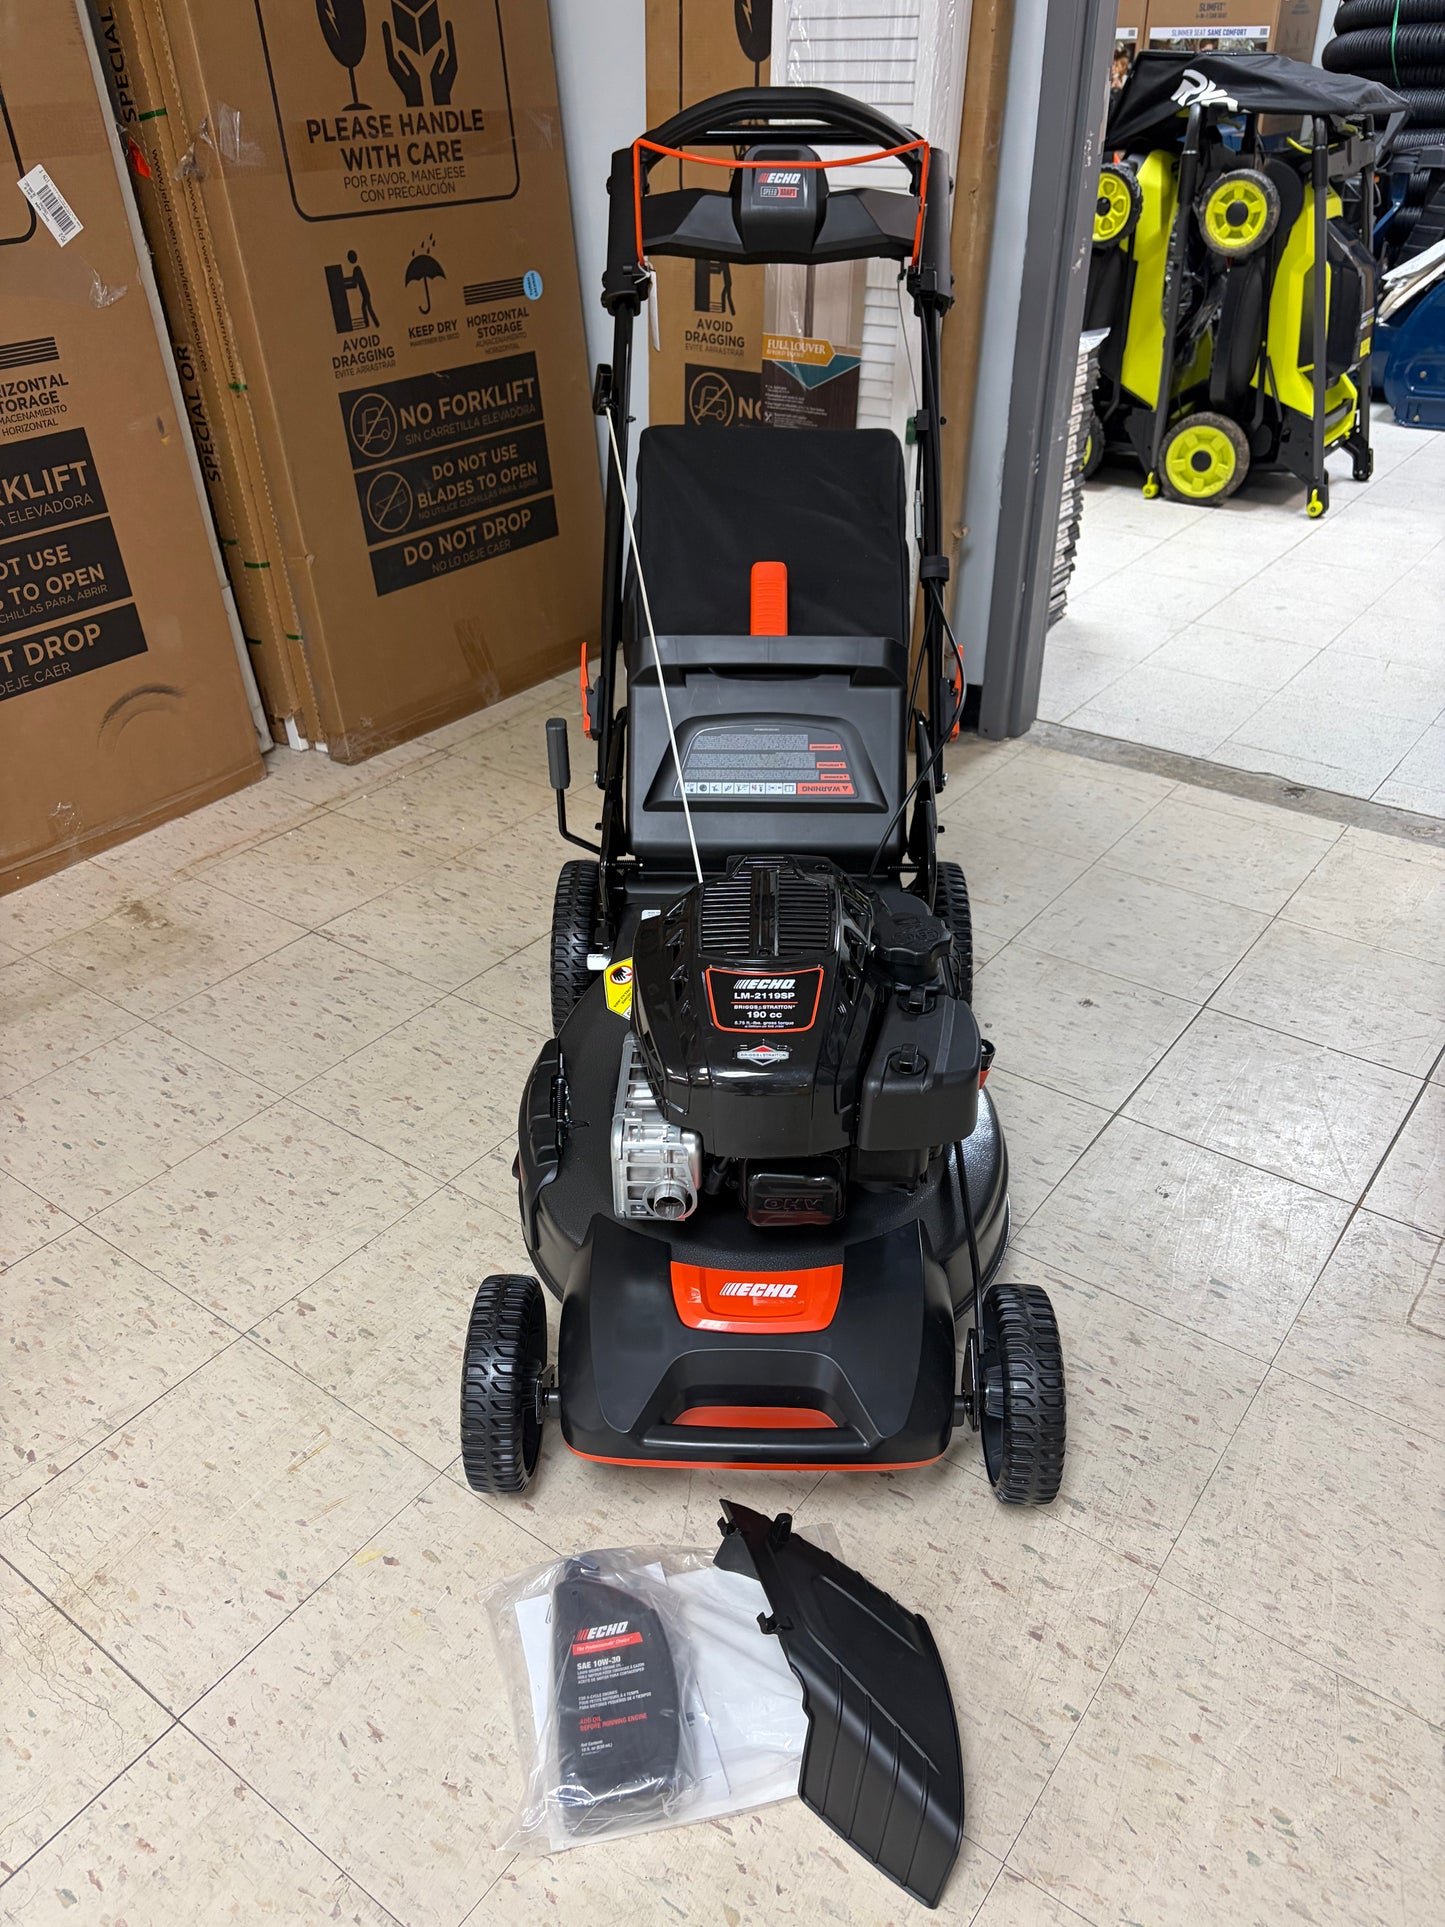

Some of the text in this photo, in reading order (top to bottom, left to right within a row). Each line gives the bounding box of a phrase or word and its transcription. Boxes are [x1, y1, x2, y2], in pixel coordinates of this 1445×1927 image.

[101, 7, 137, 123] SPECIAL
[306, 109, 485, 144] PLEASE HANDLE
[340, 139, 464, 172] WITH CARE
[343, 165, 466, 189] POR FAVOR, MANEJESE
[766, 172, 801, 184] ECHO
[360, 181, 456, 203] CON PRECAUCIÓN
[466, 306, 529, 328] HORIZONTAL
[696, 318, 734, 333] AVOID
[408, 319, 458, 339] KEEP DRY
[477, 321, 523, 339] STORAGE
[685, 330, 745, 348] DRAGGING
[343, 334, 381, 352] AVOID
[768, 339, 826, 355] FULL LOUVER
[332, 346, 395, 369] DRAGGING
[0, 373, 69, 399] IZONTAL
[0, 390, 60, 415] TORAGE
[399, 377, 535, 430] NO FORKLIFT
[0, 404, 67, 426] MACENAMIENTO
[2, 418, 59, 437] HORIZONTAL
[188, 388, 221, 482] SPECIAL
[432, 443, 518, 480] DO NOT USE
[0, 460, 87, 506] KLIFT
[417, 460, 537, 509] BLADES TO OPEN
[8, 492, 94, 525] ELEVADORA
[404, 509, 531, 566] DO NOT DROP
[0, 544, 72, 580] OT USE
[8, 563, 105, 605] TO OPEN
[0, 603, 43, 624] CHILLAS
[45, 594, 75, 611] PARA
[77, 584, 108, 602] ABRIR
[23, 623, 101, 666] DROP
[33, 661, 72, 683] CAER
[746, 979, 796, 989] ECHO
[734, 992, 796, 1000] LM-2119SP
[747, 1011, 767, 1019] 190
[738, 1283, 799, 1298] ECHO
[587, 1621, 629, 1640] ECHO
[577, 1656, 621, 1671] SAE 10W-30
